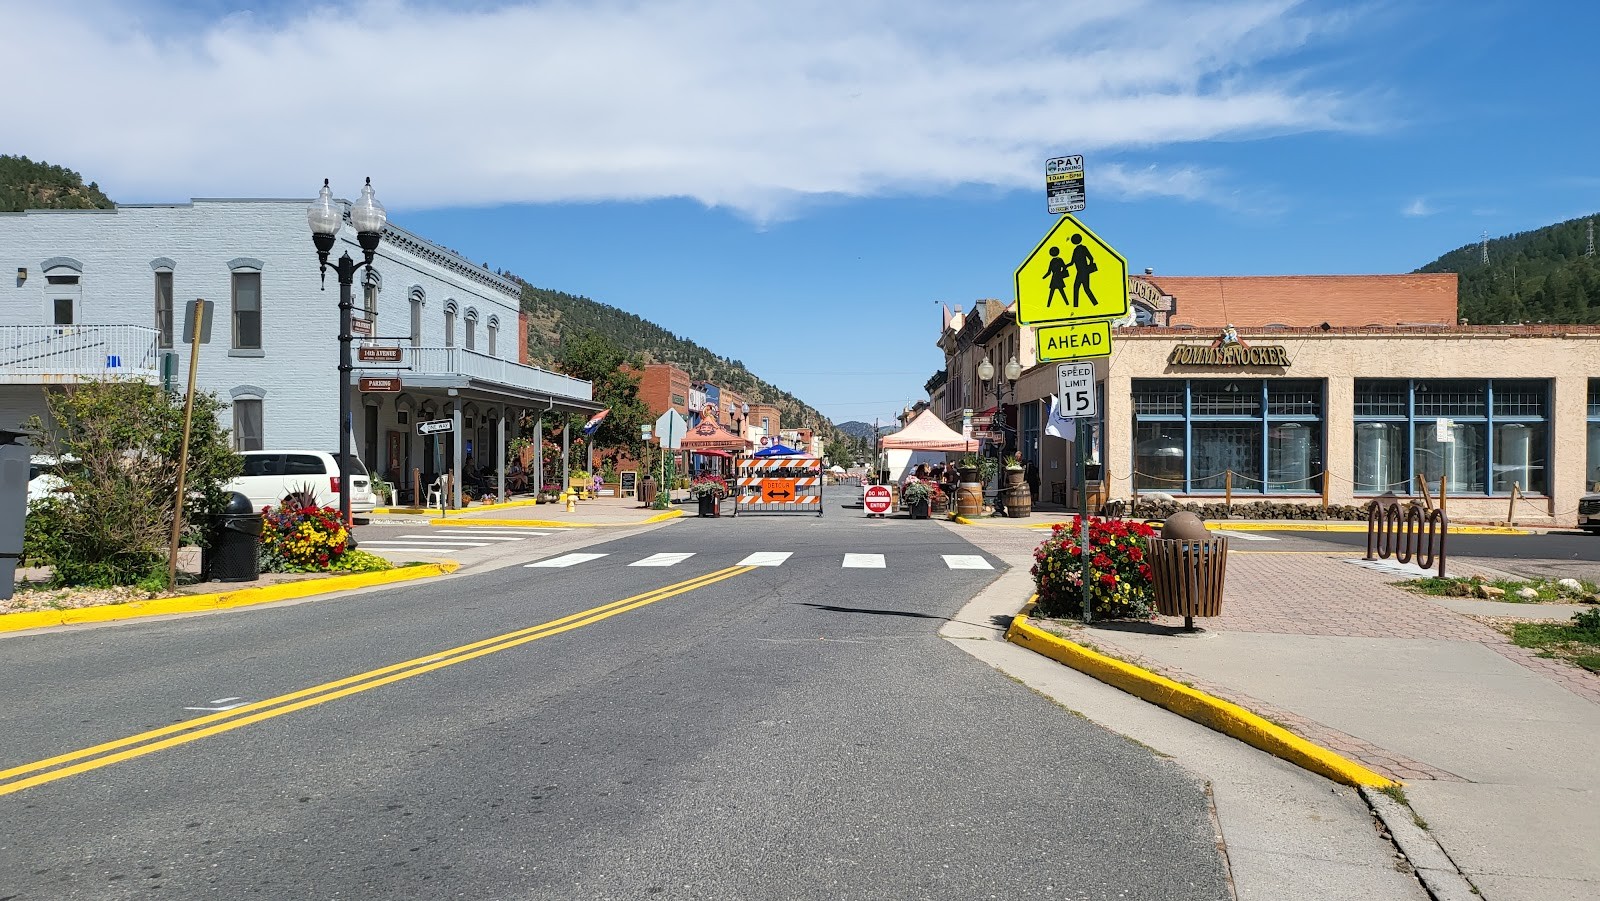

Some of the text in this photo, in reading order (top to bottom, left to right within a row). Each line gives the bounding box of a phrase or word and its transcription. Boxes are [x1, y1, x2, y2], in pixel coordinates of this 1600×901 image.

[1057, 157, 1080, 167] PAY
[1128, 278, 1162, 309] NOCKER
[1048, 332, 1102, 350] AHEAD
[1171, 345, 1291, 367] TOMMYKNOCKER
[1061, 368, 1091, 377] SPEED
[1064, 380, 1087, 388] LIMIT
[1064, 391, 1090, 411] 15
